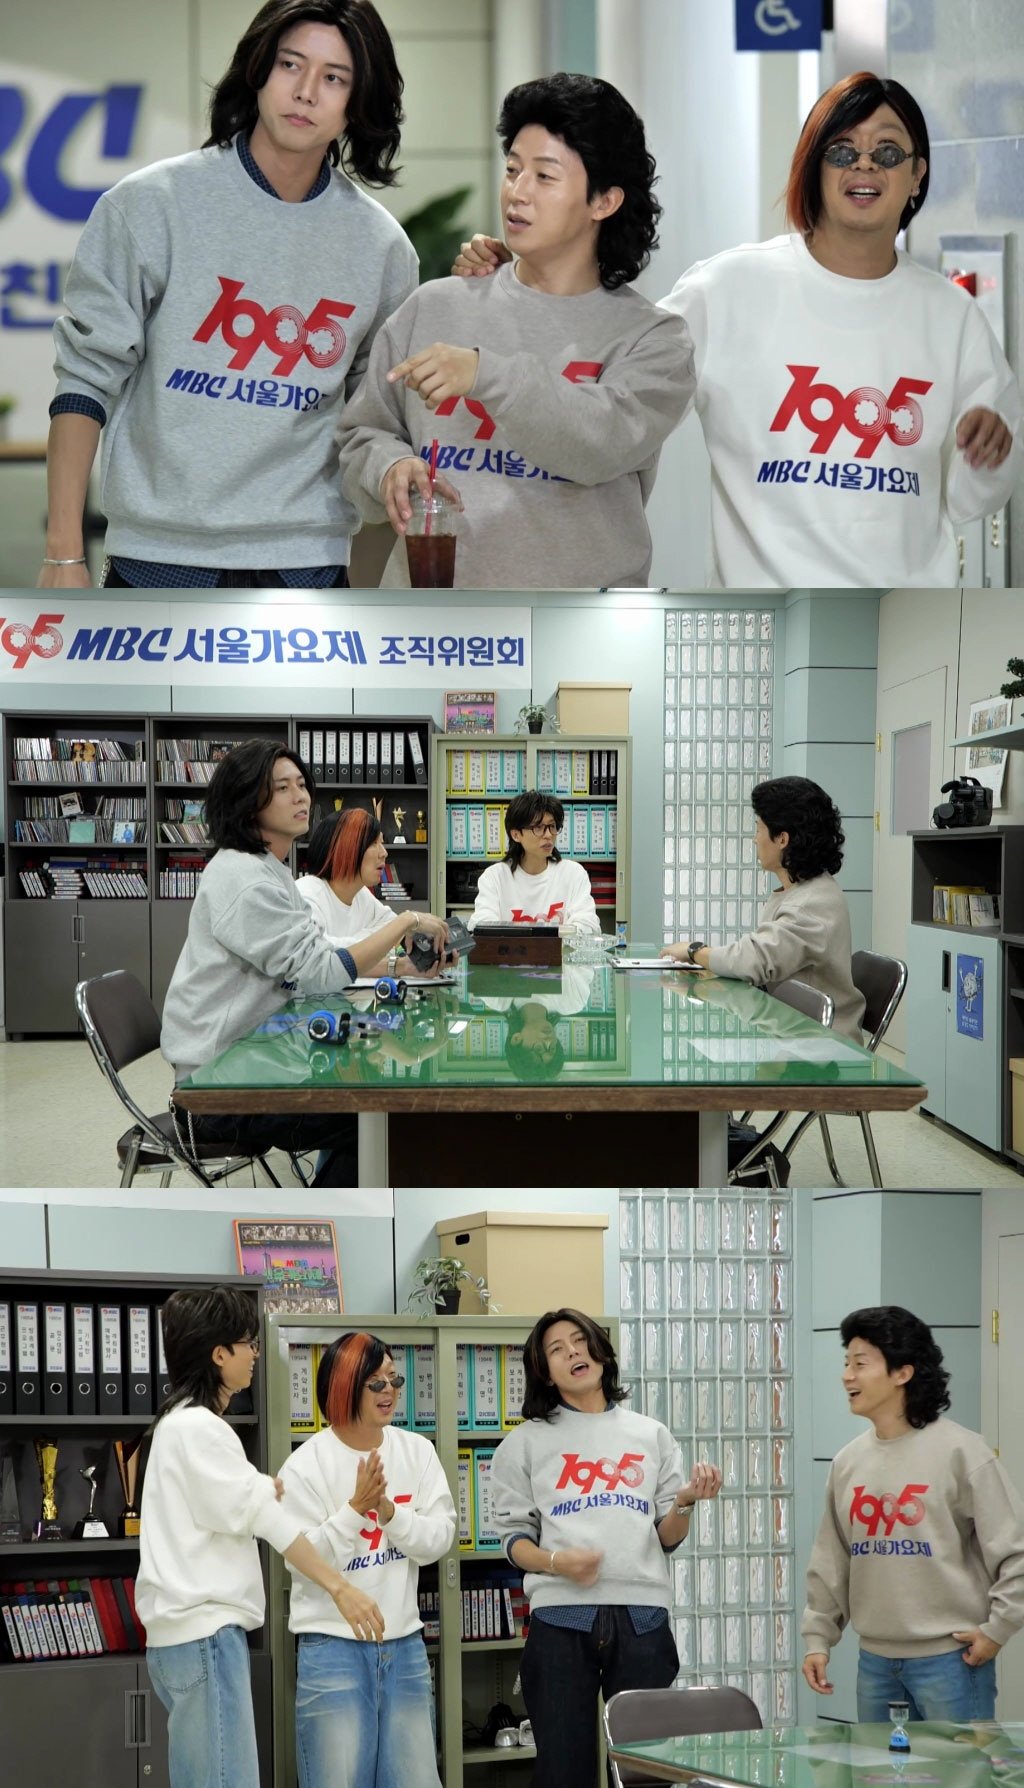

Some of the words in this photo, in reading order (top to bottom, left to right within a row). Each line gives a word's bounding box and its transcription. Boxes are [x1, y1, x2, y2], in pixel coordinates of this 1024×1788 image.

[192, 276, 356, 378] 1995
[165, 368, 227, 399] MBC
[769, 364, 933, 459] 1995
[757, 460, 811, 483] MBC
[813, 462, 920, 496] 서울가요제
[66, 627, 173, 662] MBC
[173, 627, 367, 665] 서울가요제
[379, 636, 524, 666] 조직위원회
[555, 1453, 645, 1494] 1995
[550, 1499, 582, 1516] MBC
[584, 1493, 649, 1515] 서울가요제
[849, 1484, 929, 1536] 1995
